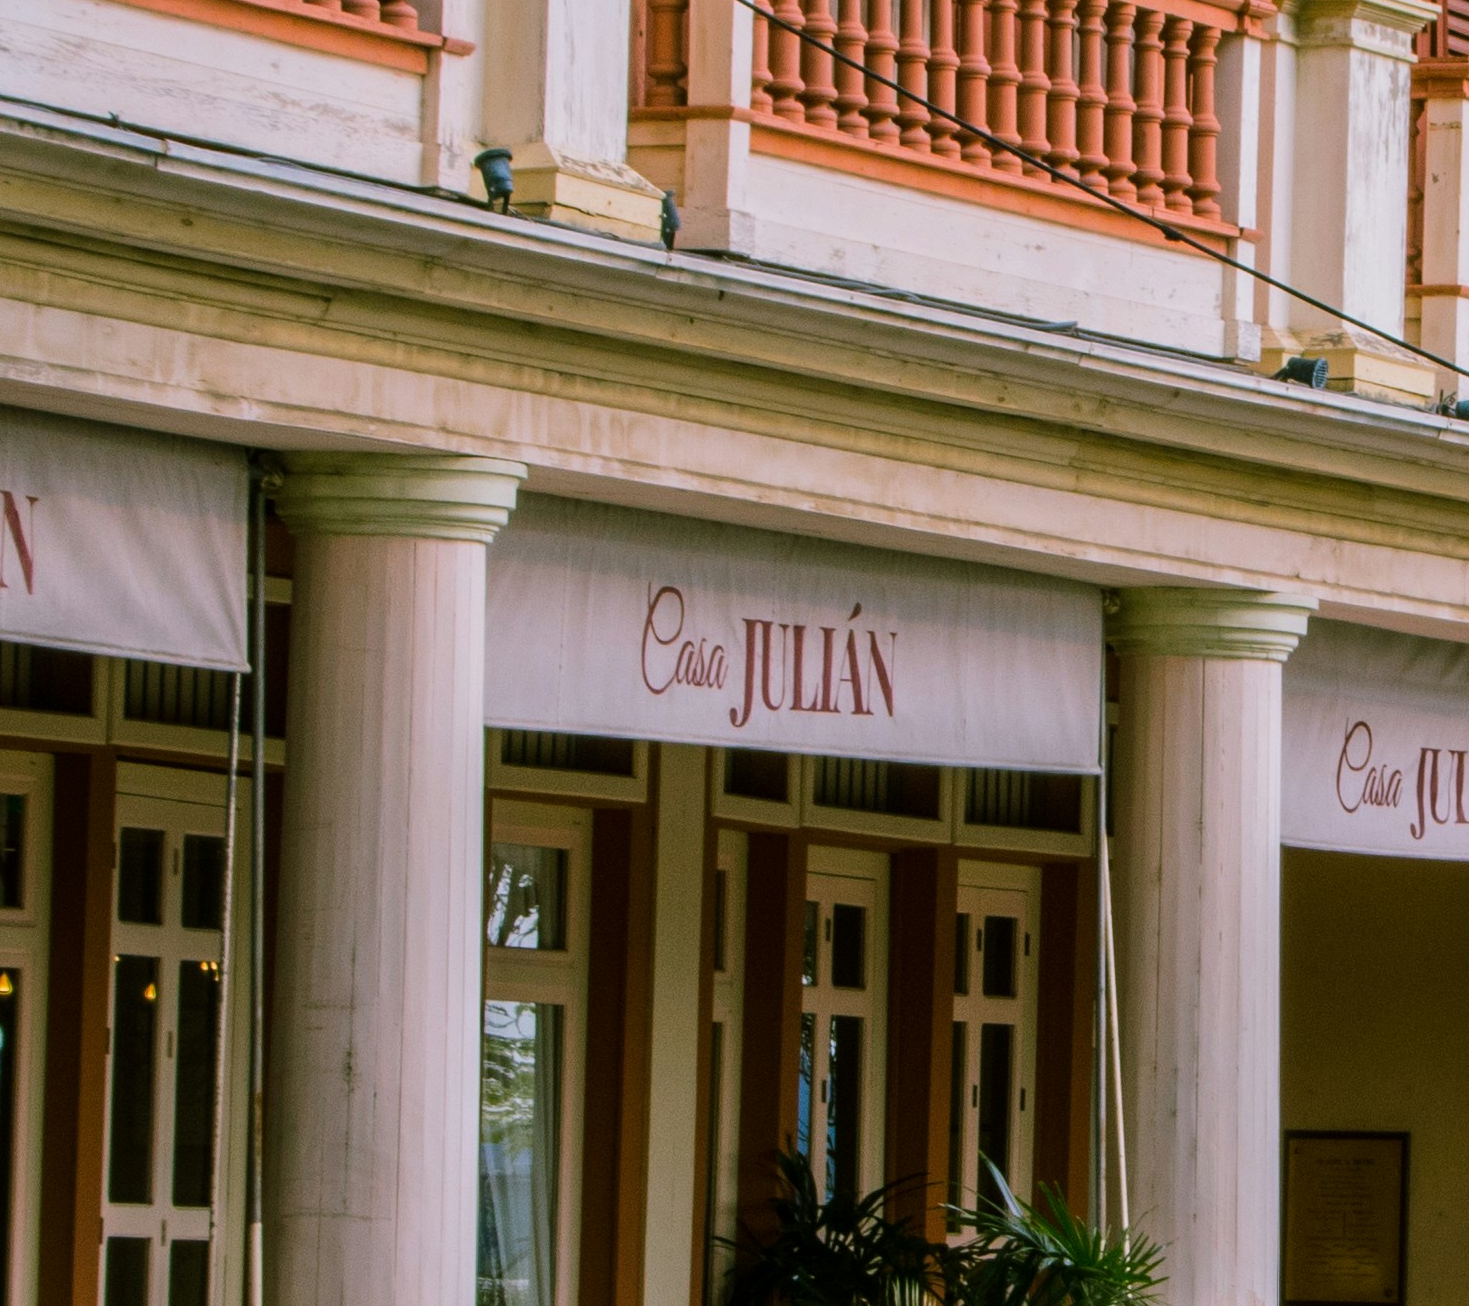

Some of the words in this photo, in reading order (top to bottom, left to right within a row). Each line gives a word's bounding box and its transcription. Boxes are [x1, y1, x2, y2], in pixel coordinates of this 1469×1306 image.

[641, 581, 729, 695] Casa
[729, 602, 898, 729] JULIÁN
[1336, 716, 1403, 814] Casa
